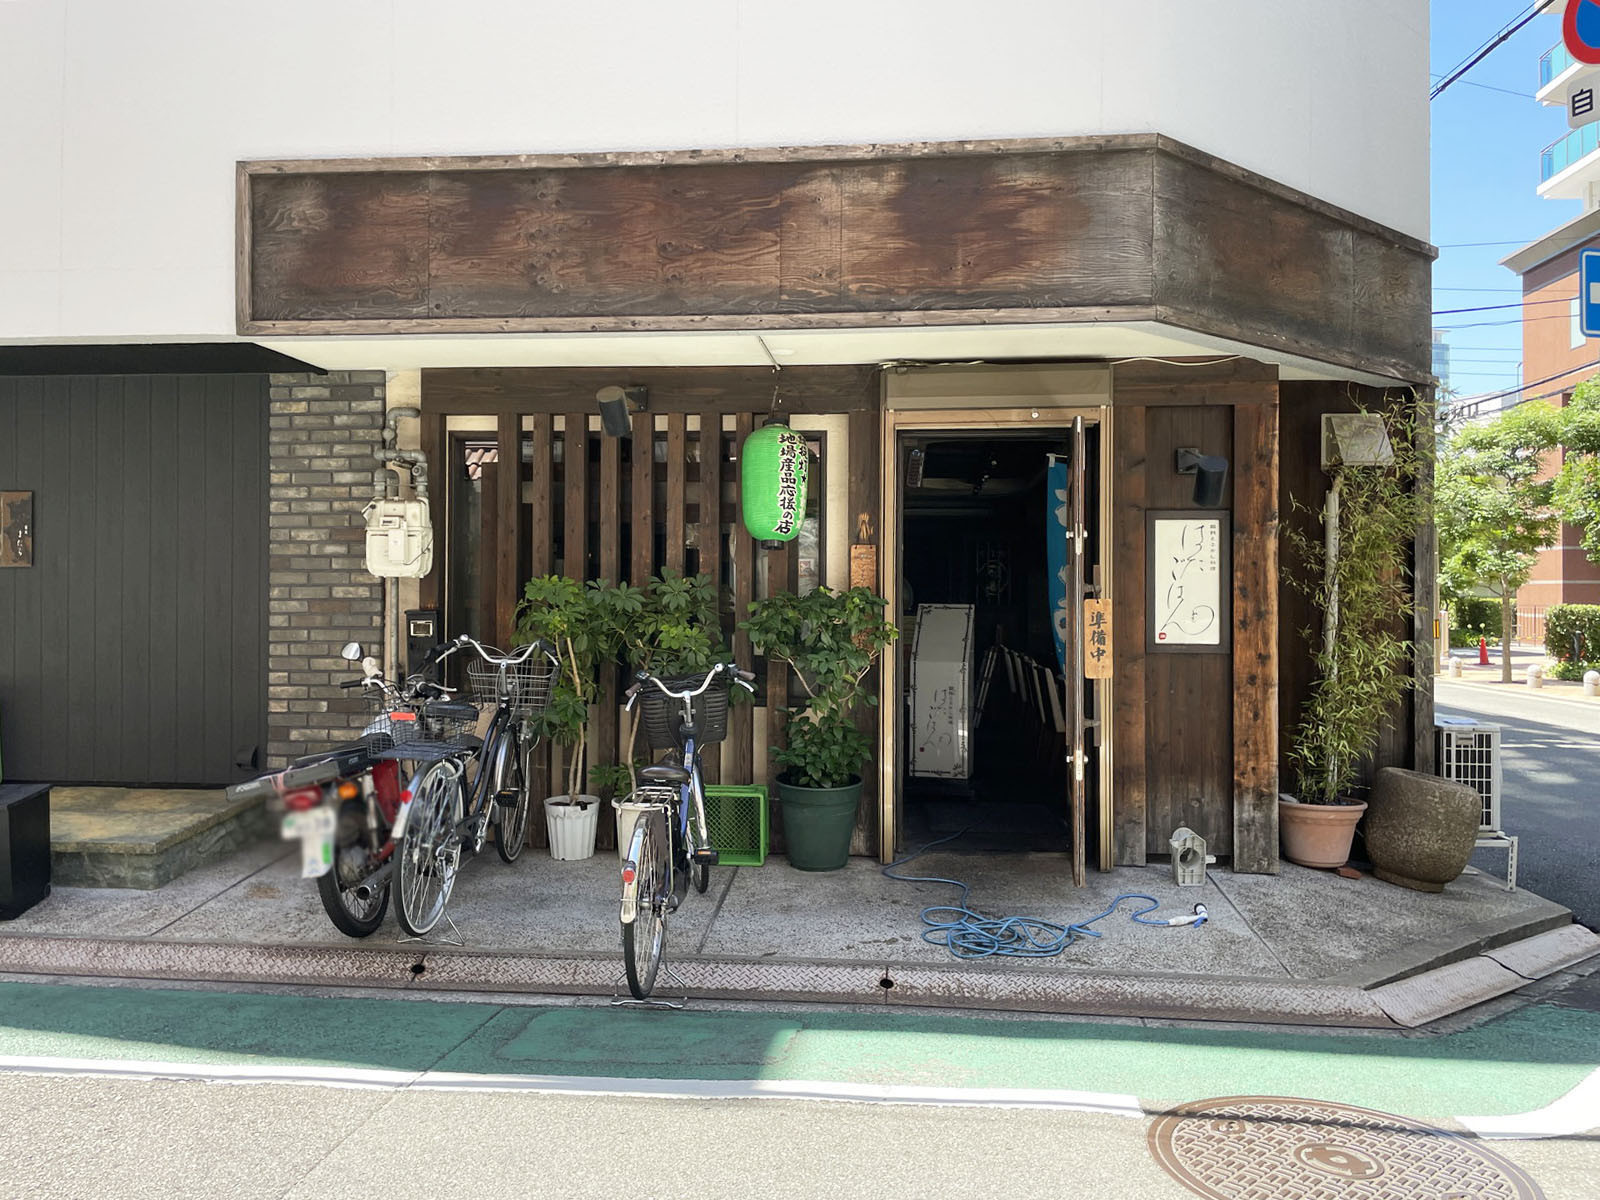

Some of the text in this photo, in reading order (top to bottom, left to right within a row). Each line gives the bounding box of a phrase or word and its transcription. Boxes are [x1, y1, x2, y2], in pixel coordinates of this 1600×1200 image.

[1571, 88, 1593, 117] 自
[774, 432, 797, 535] 地場産品応援の店
[1088, 611, 1108, 663] 準備中
